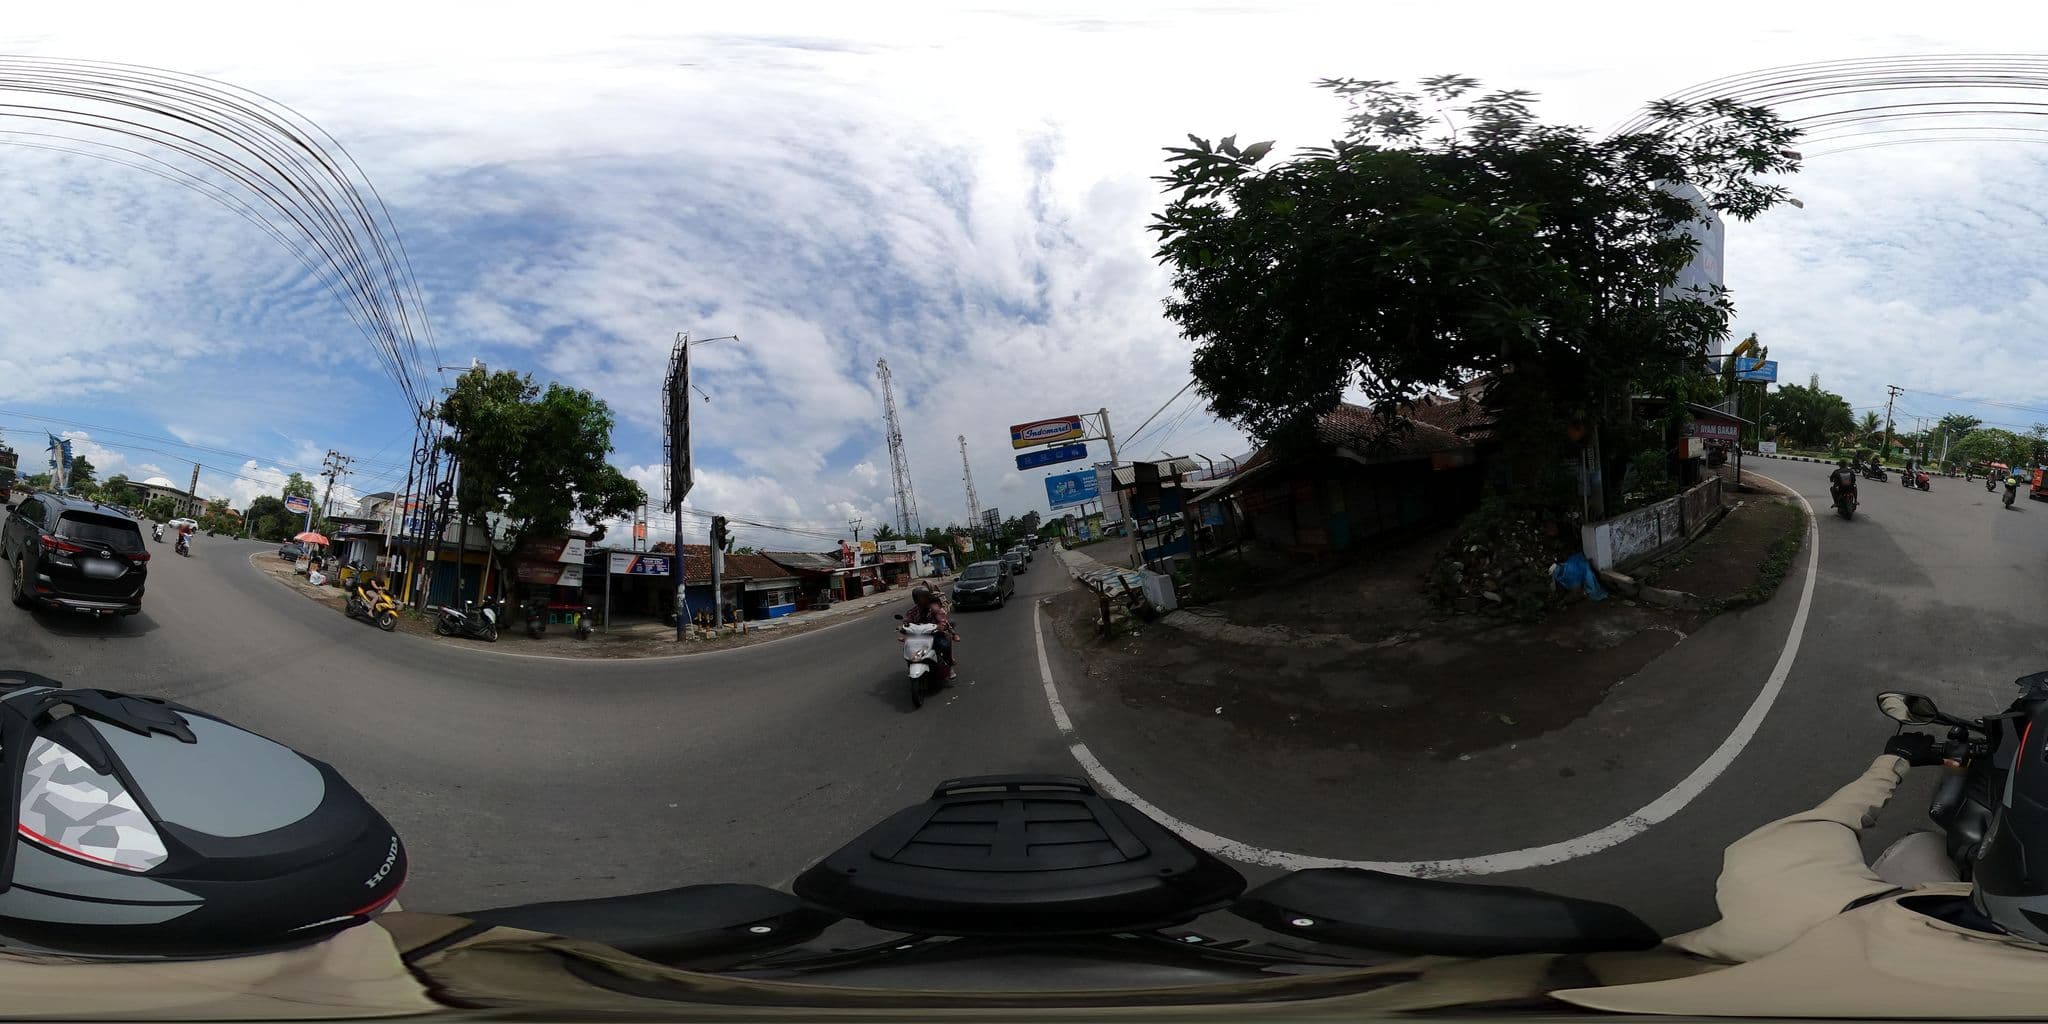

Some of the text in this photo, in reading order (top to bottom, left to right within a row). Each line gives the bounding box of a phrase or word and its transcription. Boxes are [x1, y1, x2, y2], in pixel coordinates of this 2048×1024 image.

[1025, 424, 1068, 438] Indomaret
[1717, 426, 1738, 436] BAKAR
[365, 836, 398, 888] HONDA
